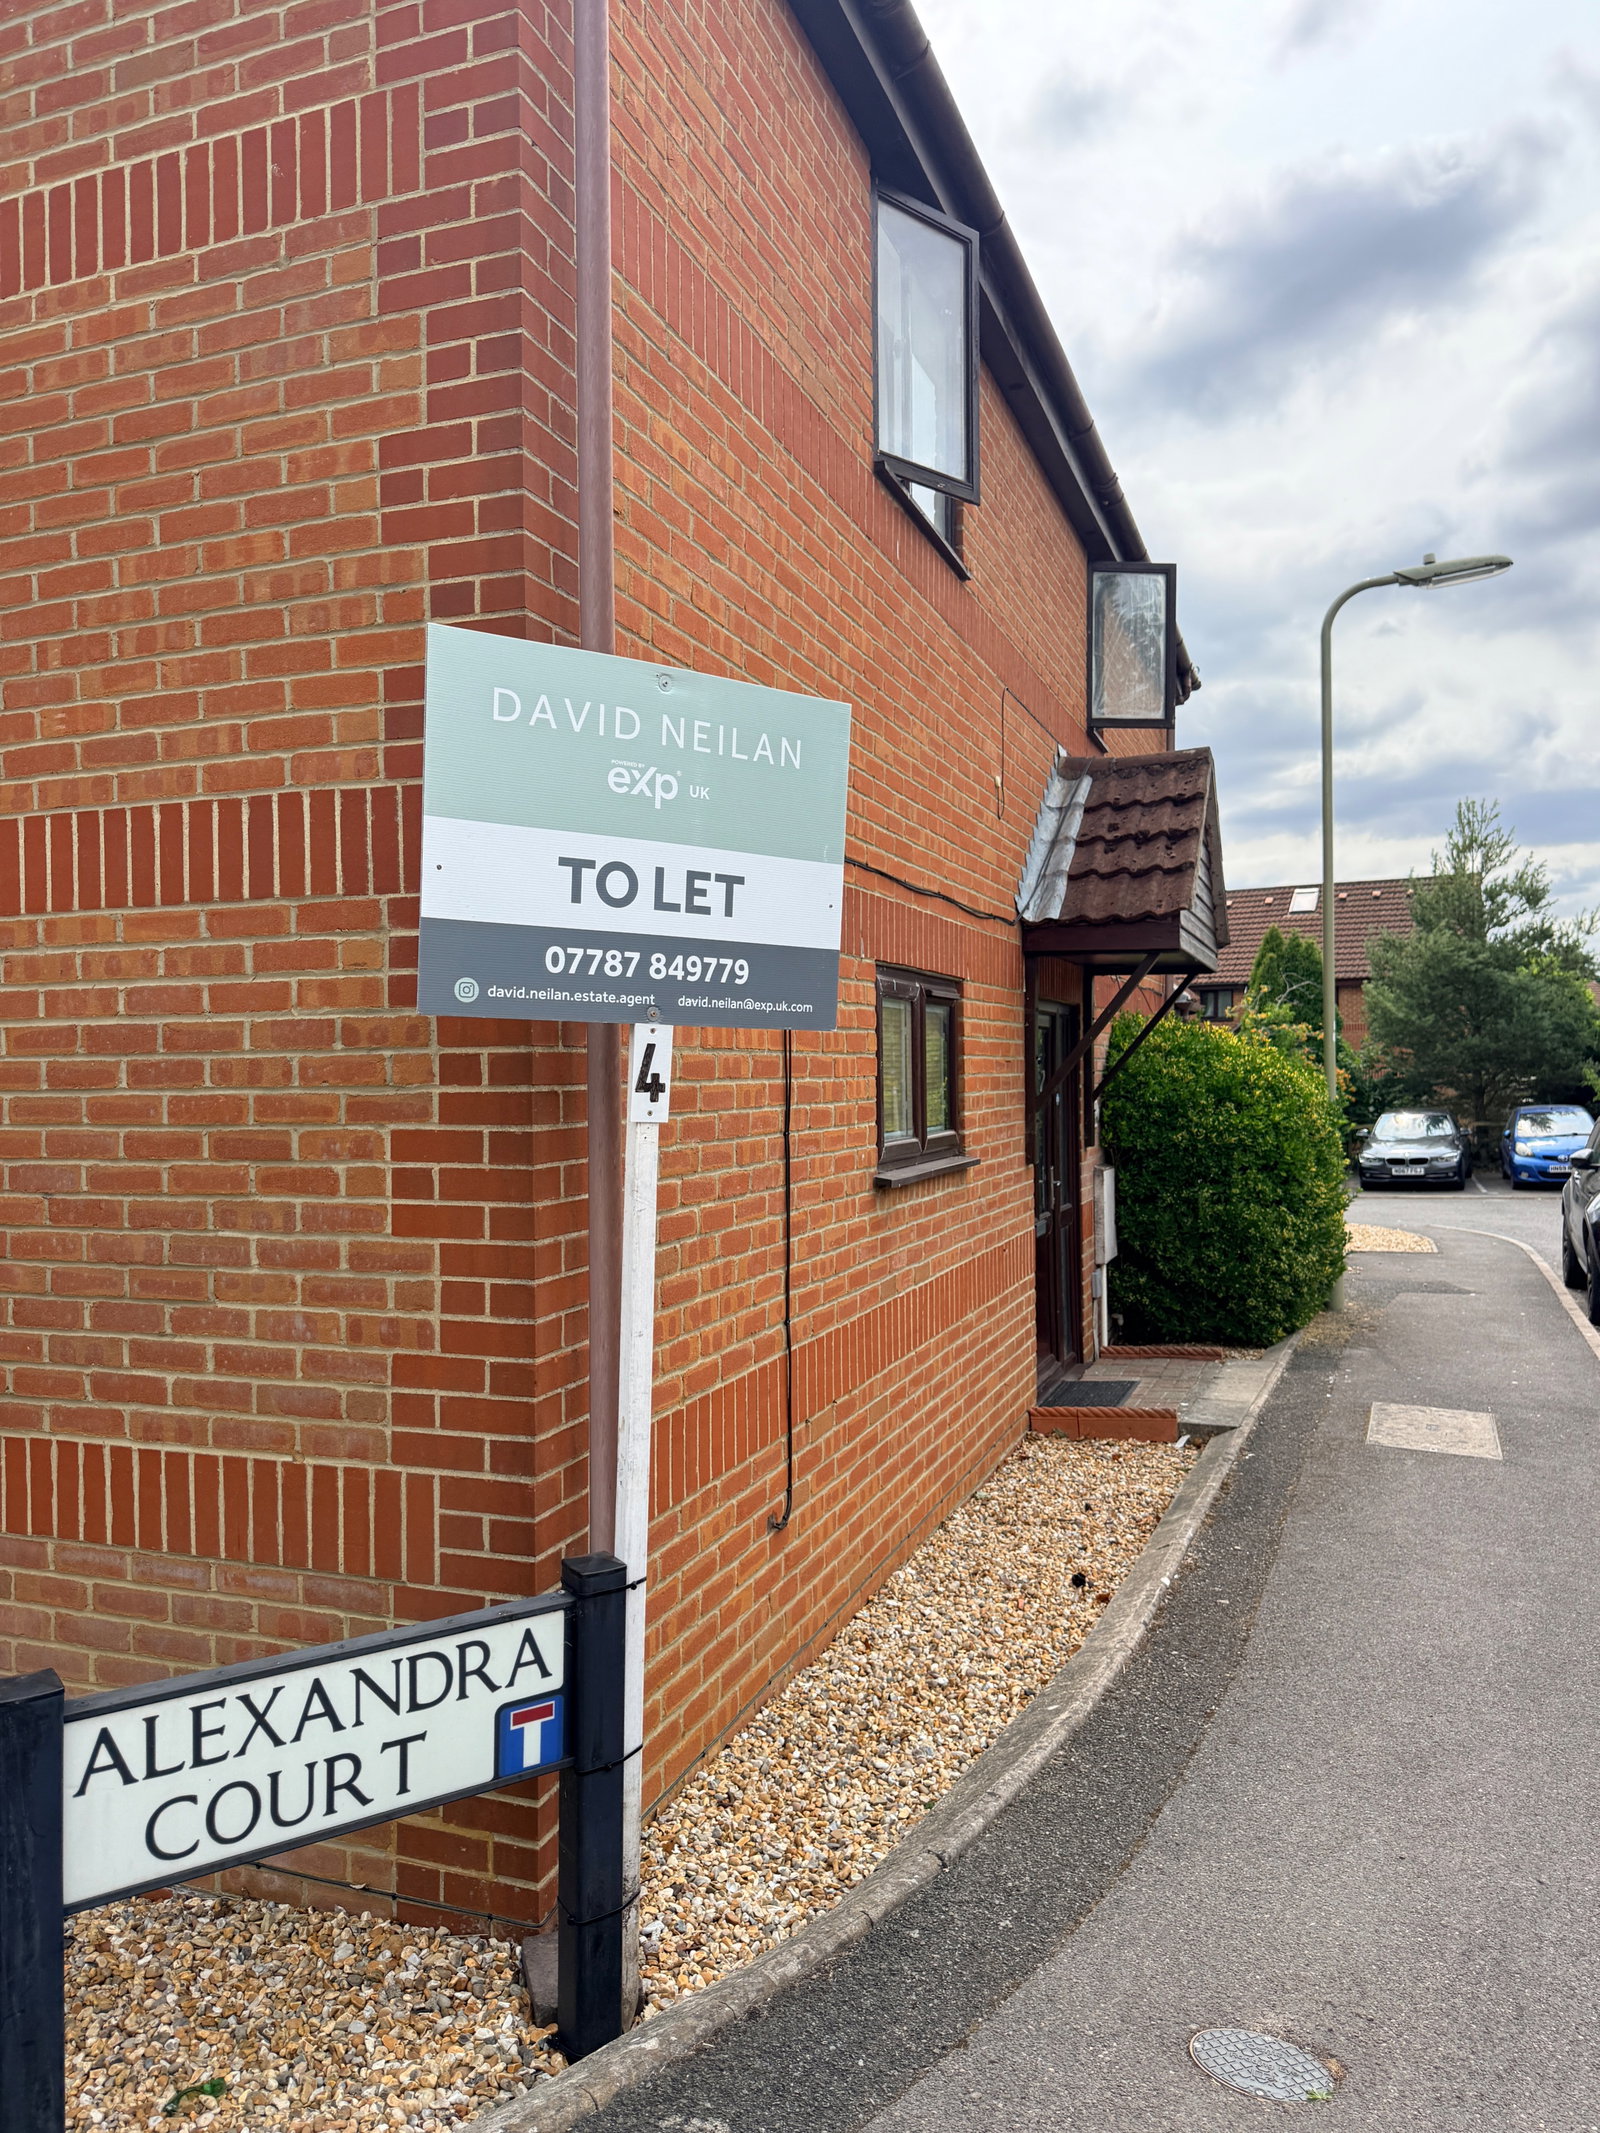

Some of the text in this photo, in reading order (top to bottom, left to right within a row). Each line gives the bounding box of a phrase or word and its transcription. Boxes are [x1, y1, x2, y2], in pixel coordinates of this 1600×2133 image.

[492, 687, 802, 770] DAVID NEILAN
[611, 759, 638, 768] POWERED
[689, 785, 710, 800] UK
[558, 856, 746, 919] TO LET
[545, 945, 750, 985] 07787 849779
[487, 985, 656, 1007] david.neilan.estate.agent
[678, 995, 813, 1014] david.neilan@exp.uk.com
[634, 1043, 667, 1103] 4
[73, 1627, 553, 1798] ALEXANDRA
[144, 1730, 427, 1861] COURT
